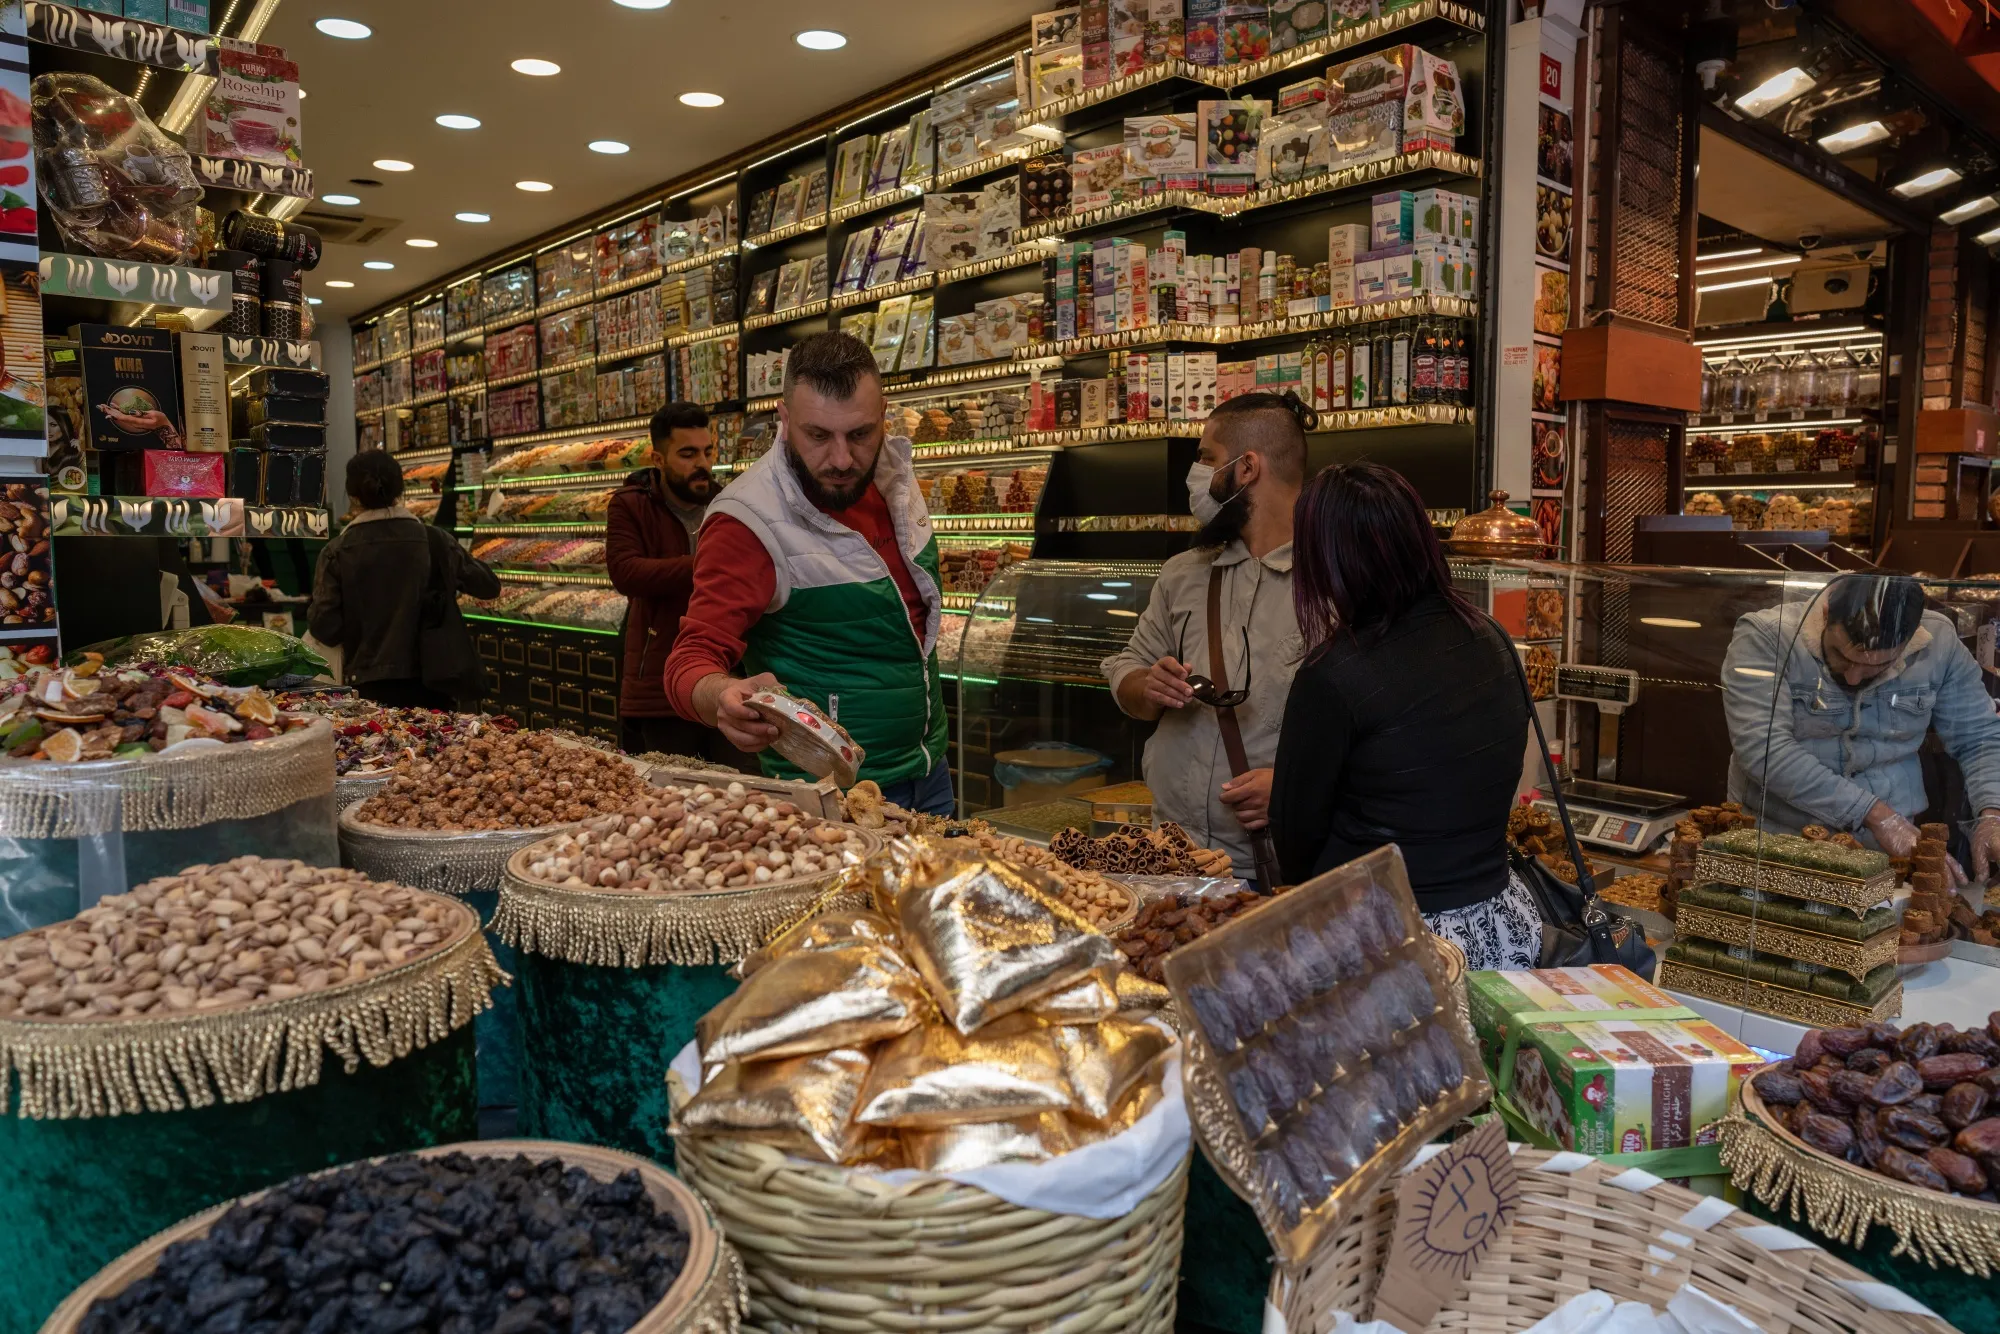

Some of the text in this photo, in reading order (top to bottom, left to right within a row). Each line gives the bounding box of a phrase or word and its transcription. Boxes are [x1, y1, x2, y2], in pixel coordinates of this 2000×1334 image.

[1546, 65, 1558, 88] 20
[222, 77, 286, 101] Rosehip
[1094, 148, 1121, 159] HALVA
[1662, 1077, 1672, 1148] RKISH DELIGHT
[1622, 1133, 1636, 1153] RKO
